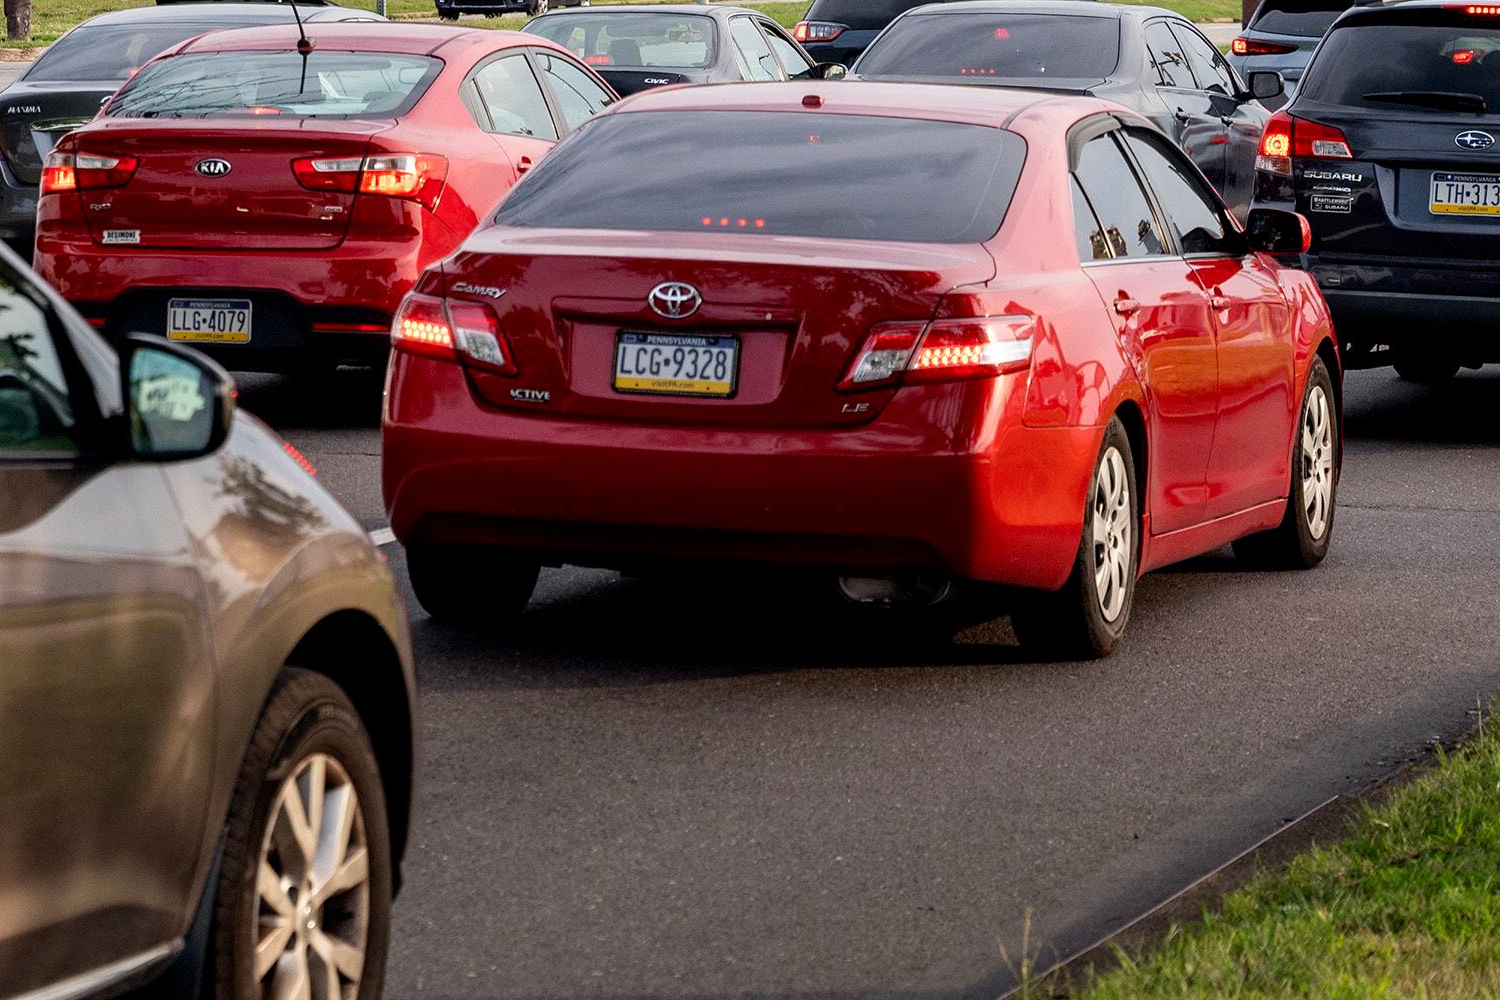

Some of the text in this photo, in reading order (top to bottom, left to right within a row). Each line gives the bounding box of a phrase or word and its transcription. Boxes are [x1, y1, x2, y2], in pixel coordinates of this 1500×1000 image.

[7, 106, 41, 114] MAXIMA
[200, 162, 224, 174] KIA
[1303, 170, 1362, 182] SUBARU
[1453, 175, 1497, 183] PENNSYLVANIA
[107, 231, 136, 239] DESIMONE
[647, 336, 707, 346] PENNSYLVANIA
[841, 403, 869, 413] LE
